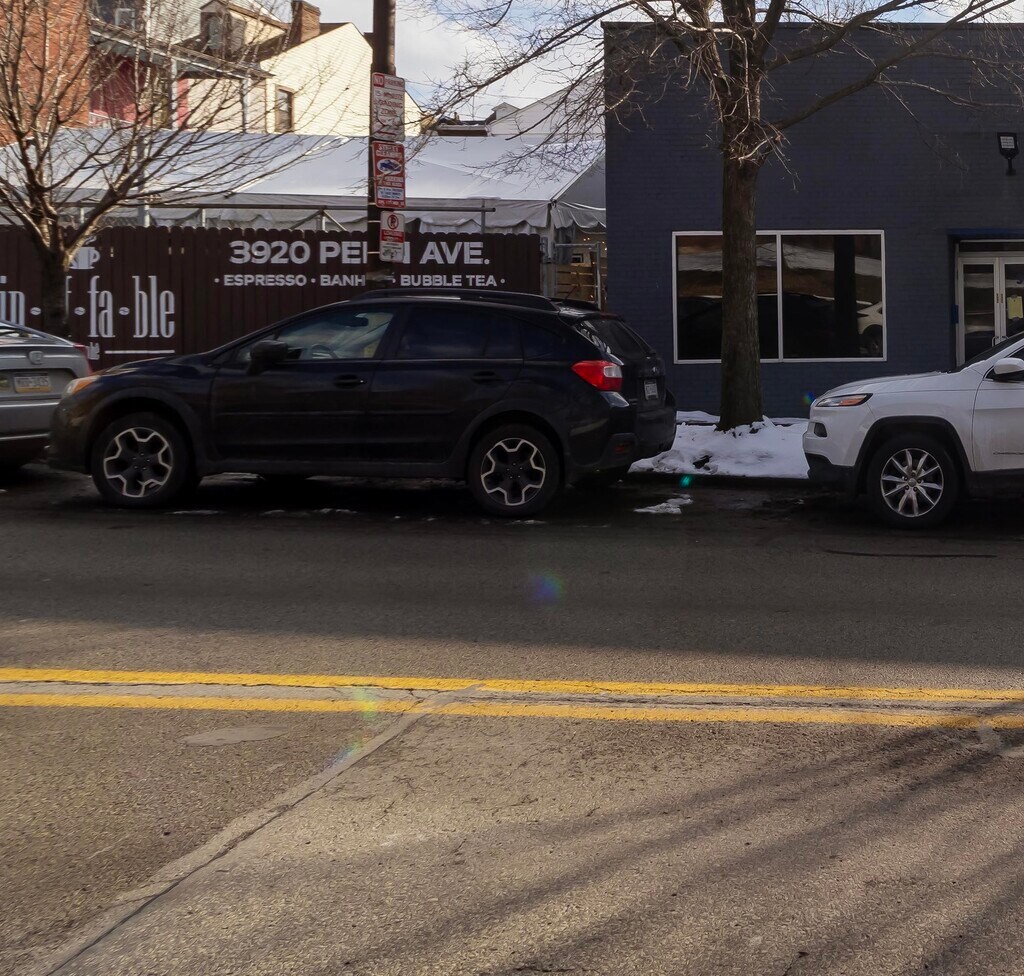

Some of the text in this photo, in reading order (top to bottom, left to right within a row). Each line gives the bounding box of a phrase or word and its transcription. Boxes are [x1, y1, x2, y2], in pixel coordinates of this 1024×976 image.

[228, 240, 311, 265] 3920
[419, 241, 490, 265] AVE.
[223, 274, 498, 287] ESPRESSO BANH BUBBLE TEA
